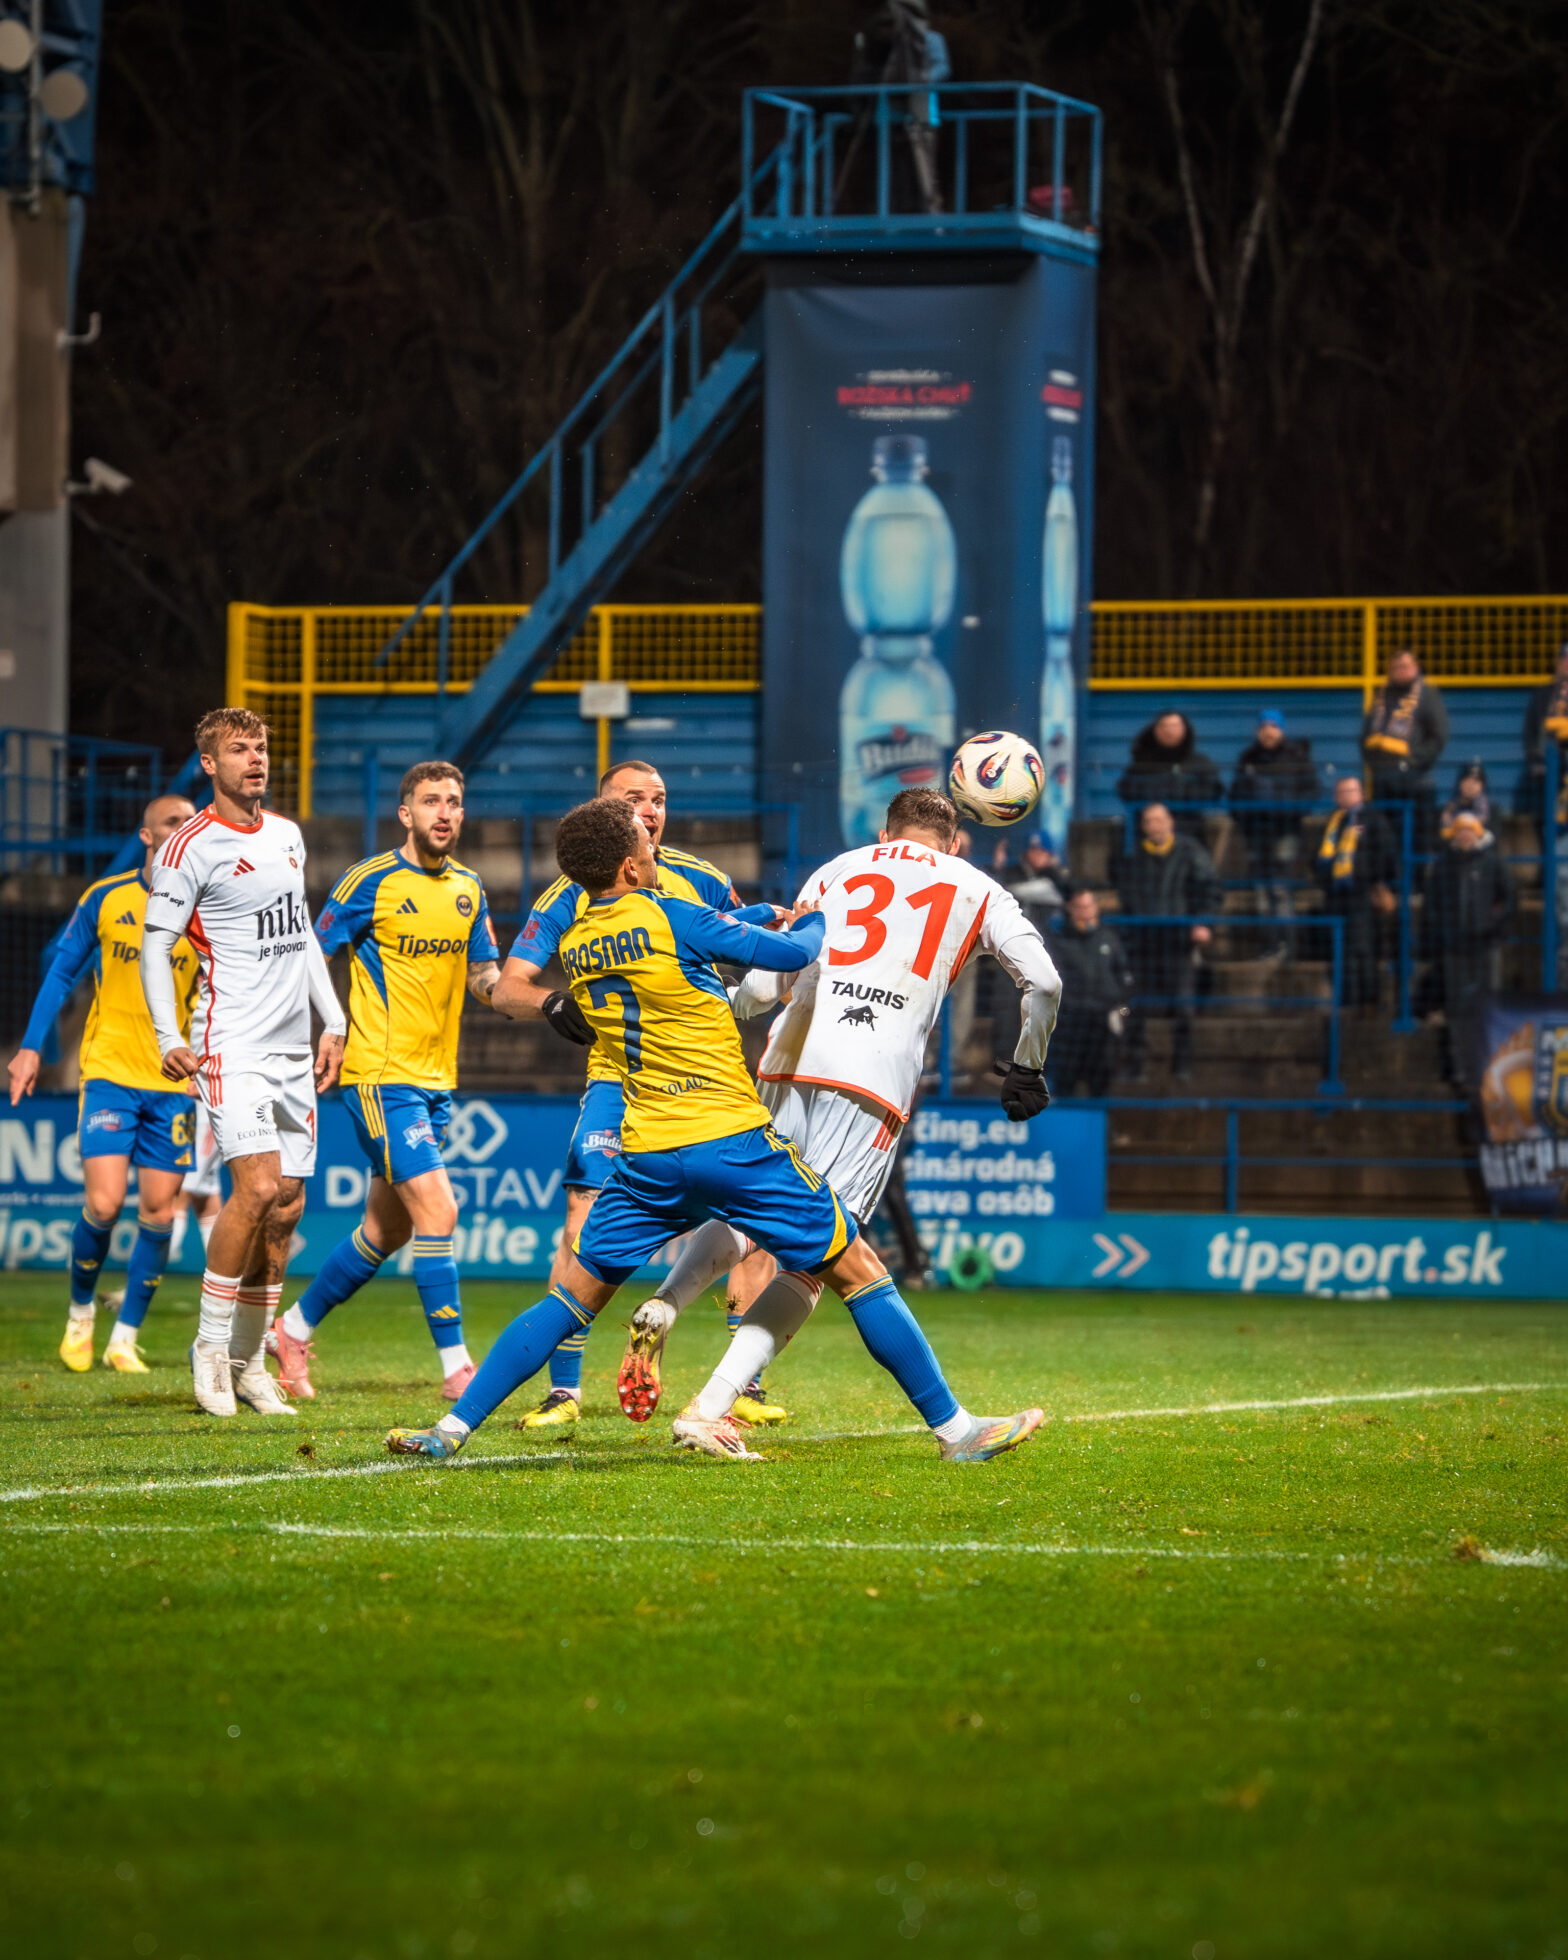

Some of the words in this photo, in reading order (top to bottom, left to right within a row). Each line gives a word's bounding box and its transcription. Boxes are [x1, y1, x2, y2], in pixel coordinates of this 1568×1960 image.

[872, 845, 936, 867] FILA
[828, 873, 958, 981] 31
[258, 946, 271, 962] je
[397, 935, 468, 958] Tipspor
[831, 980, 905, 1010] TAURIS
[586, 974, 643, 1075] 7
[237, 1130, 256, 1141] ECO
[976, 1183, 1055, 1216] osôb
[1206, 1226, 1507, 1292] tipsport.sk
